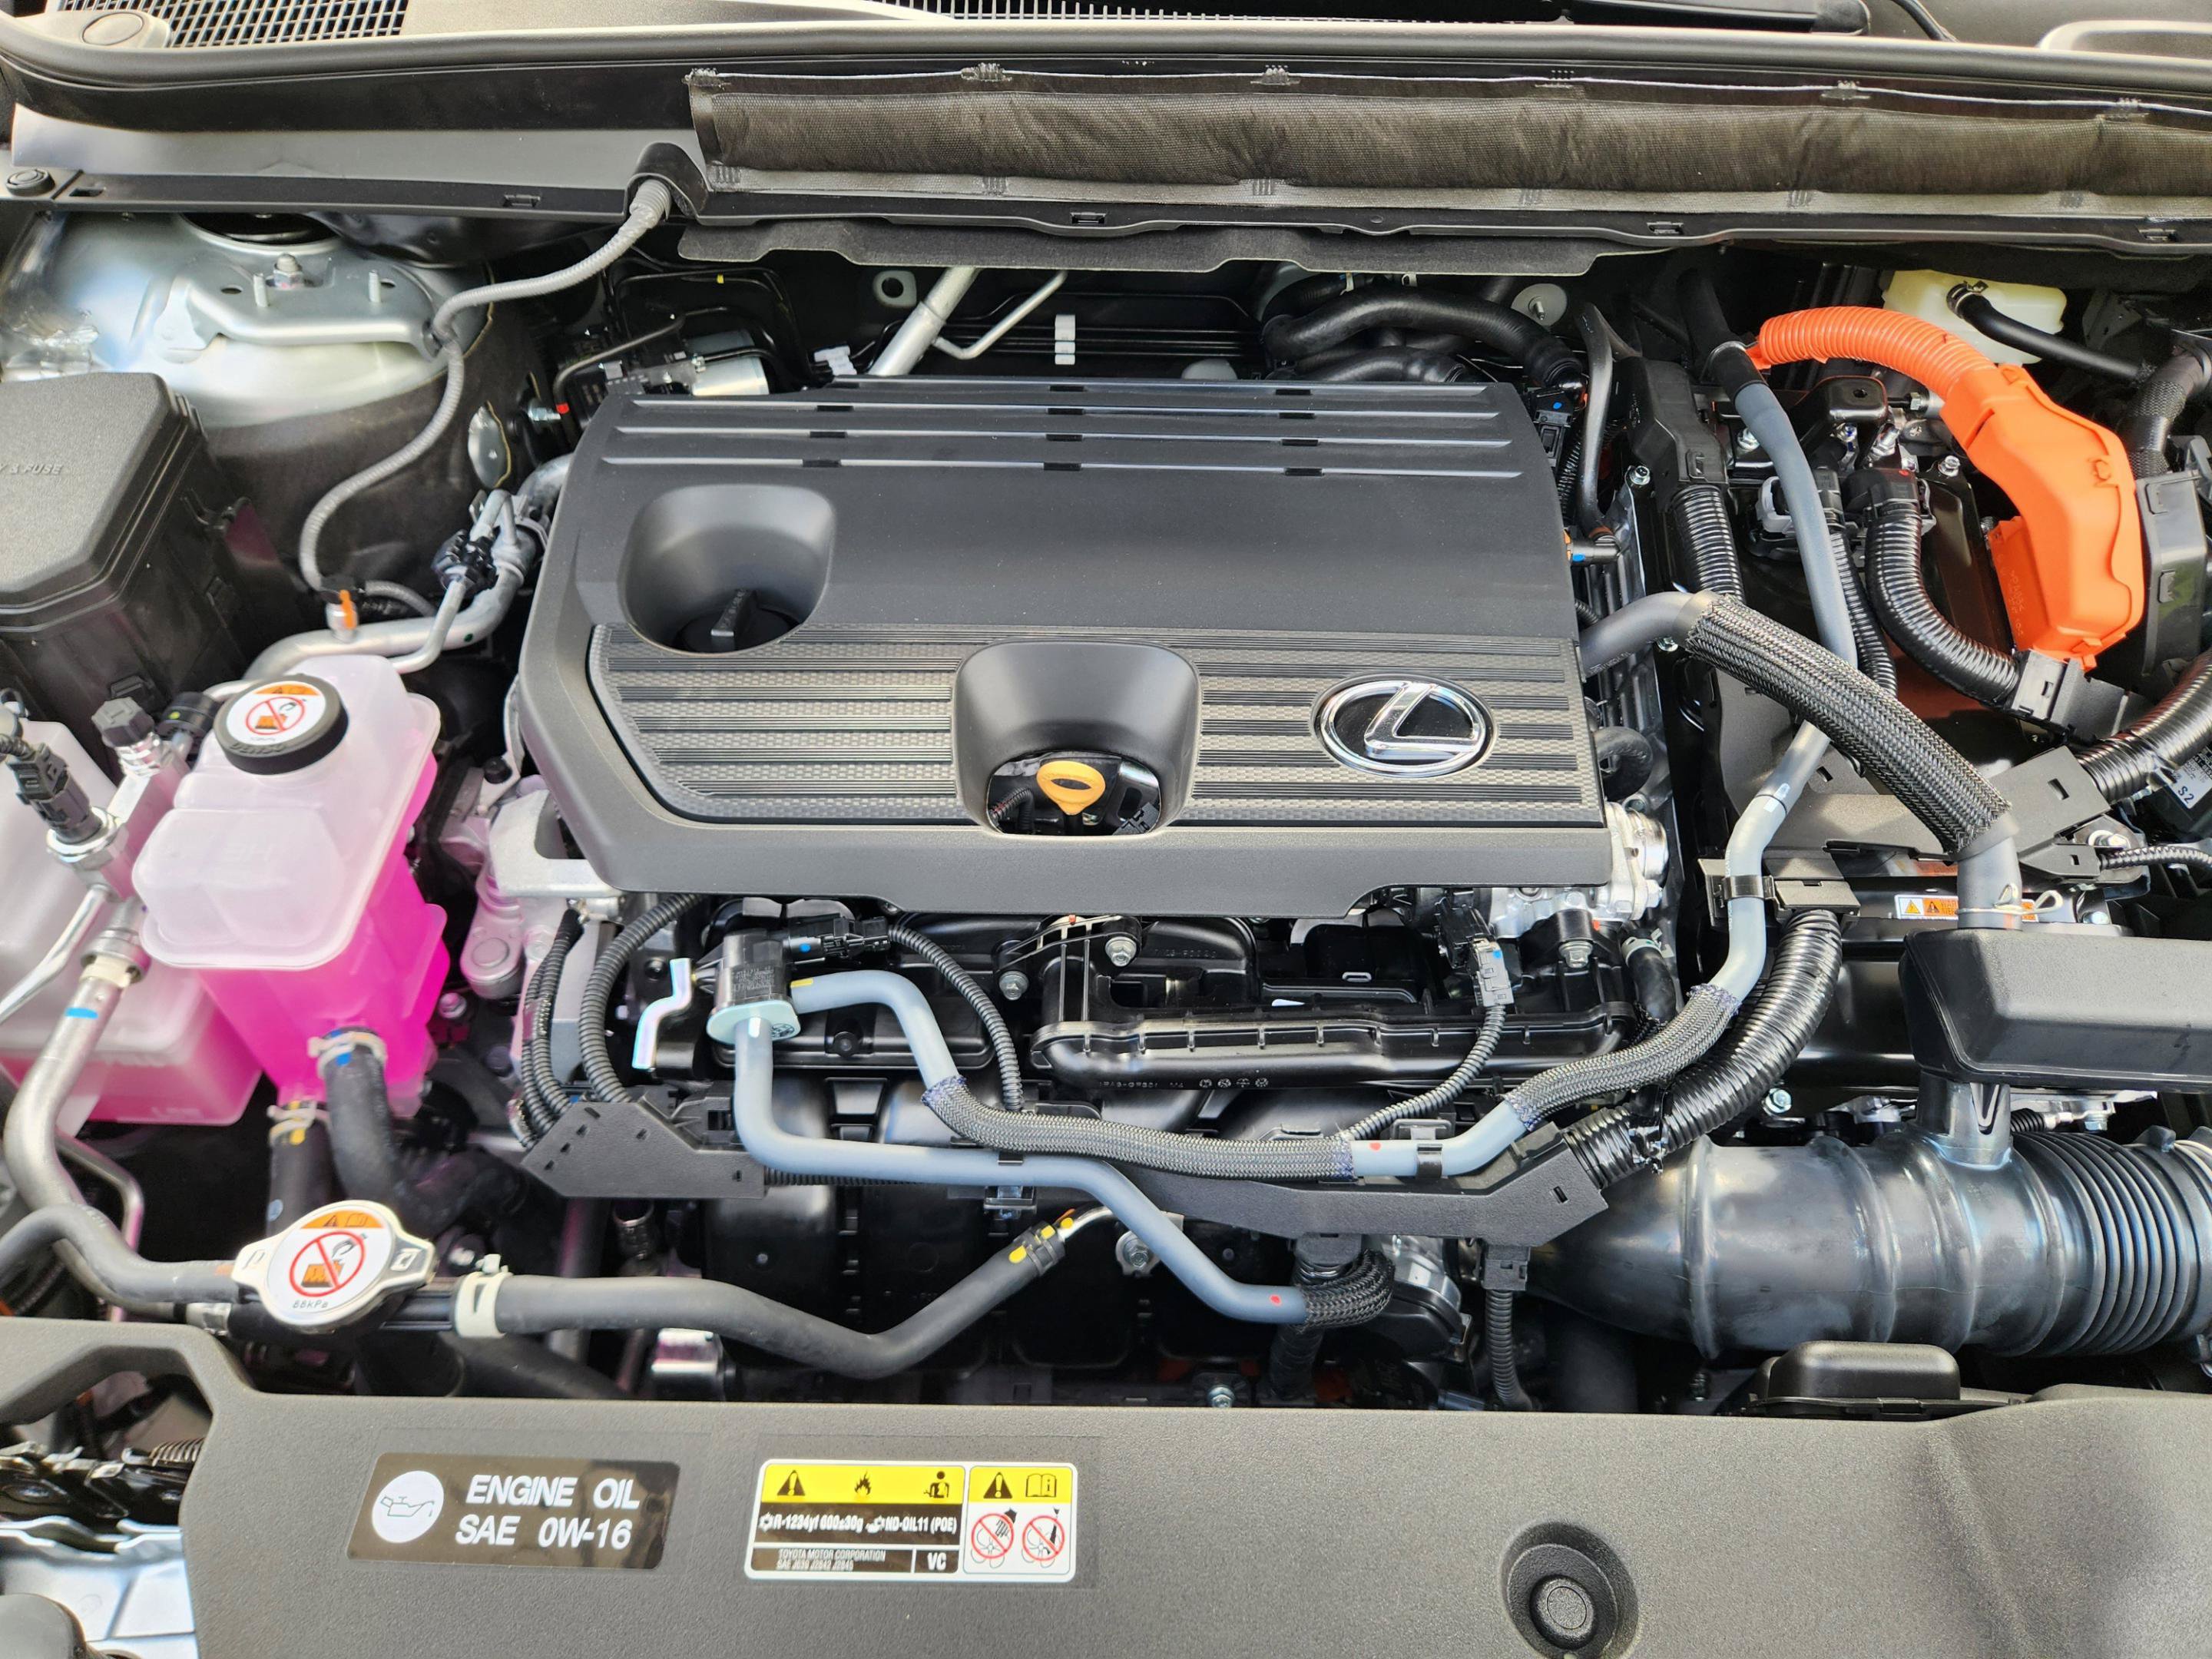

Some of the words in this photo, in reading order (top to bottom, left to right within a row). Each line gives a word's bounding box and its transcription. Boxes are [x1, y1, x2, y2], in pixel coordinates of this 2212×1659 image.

[25, 462, 64, 475] FUSE
[2178, 786, 2194, 804] S2
[465, 1475, 578, 1507] ENGINE
[593, 1478, 640, 1509] OIL
[455, 1514, 521, 1545] SAE
[538, 1517, 632, 1550] 0W-16
[885, 1515, 929, 1532] ND-OIL11
[930, 1516, 957, 1535] (POE)
[778, 1548, 806, 1560] TOYOTA
[807, 1549, 833, 1561] MOTOR
[834, 1549, 886, 1562] CORPORATION
[926, 1552, 947, 1570] VC
[777, 1559, 791, 1570] SAE
